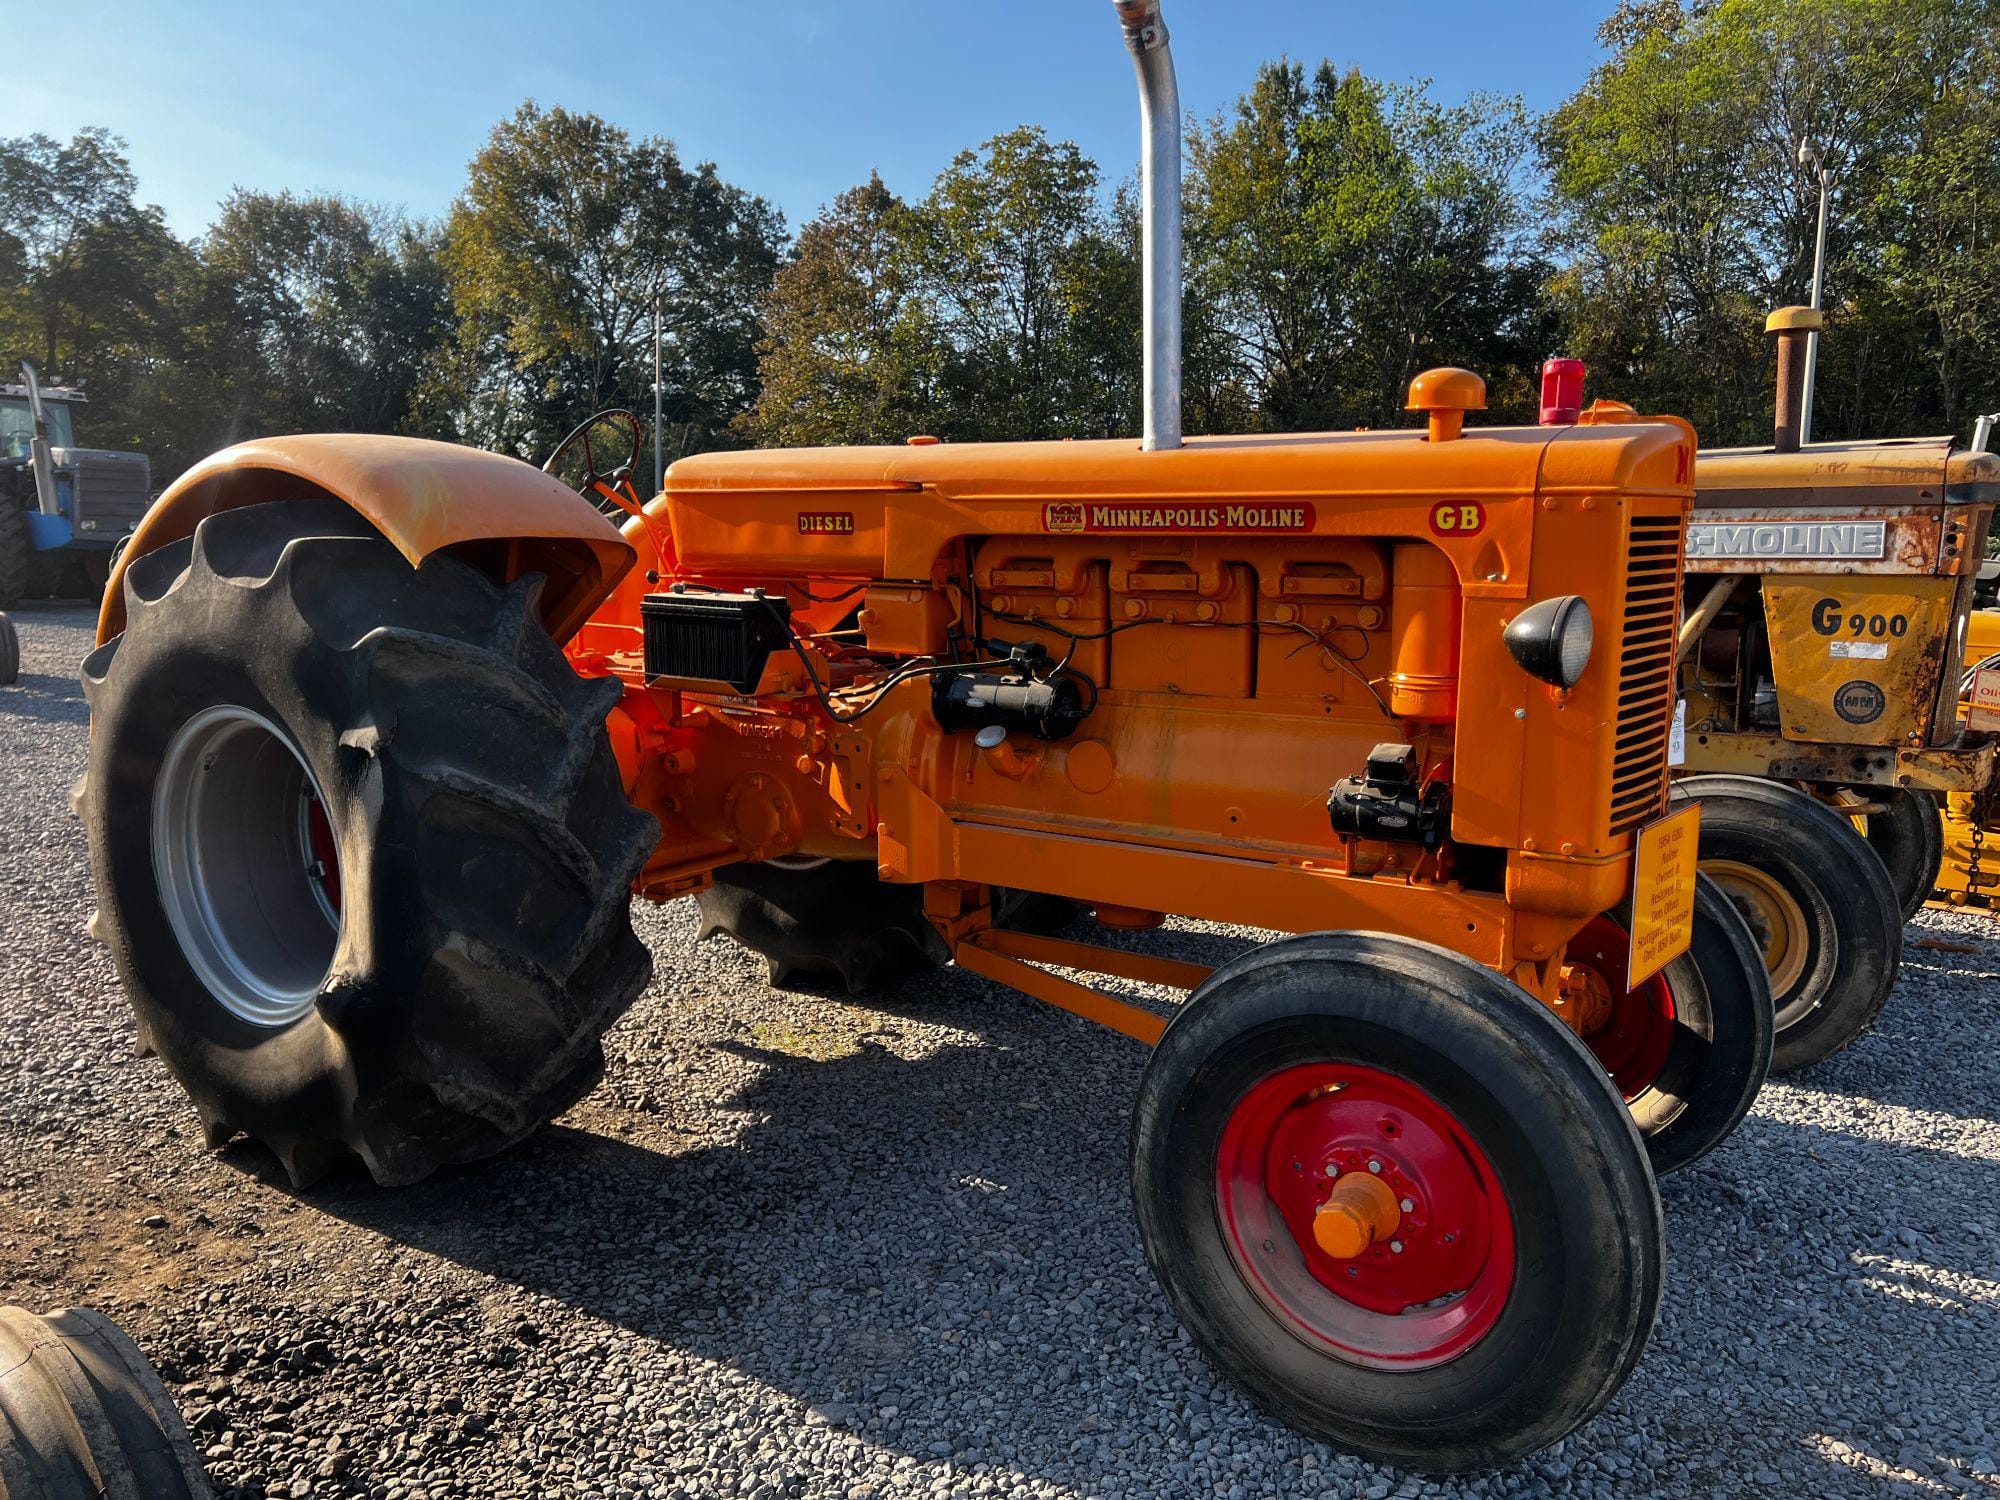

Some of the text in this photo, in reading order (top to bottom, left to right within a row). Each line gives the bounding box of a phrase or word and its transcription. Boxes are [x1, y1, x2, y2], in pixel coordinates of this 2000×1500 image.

[800, 516, 853, 531] DIESEL
[1092, 505, 1305, 528] MINNEAPOLIS-MOLINE
[1436, 506, 1479, 530] GB
[1811, 597, 1908, 638] G 900
[1981, 687, 2000, 697] Oli
[1656, 867, 1674, 885] Owned
[1650, 883, 1675, 907] Restored
[1651, 909, 1663, 924] Don
[1667, 910, 1690, 930] Arkansas
[1643, 947, 1656, 963] Only
